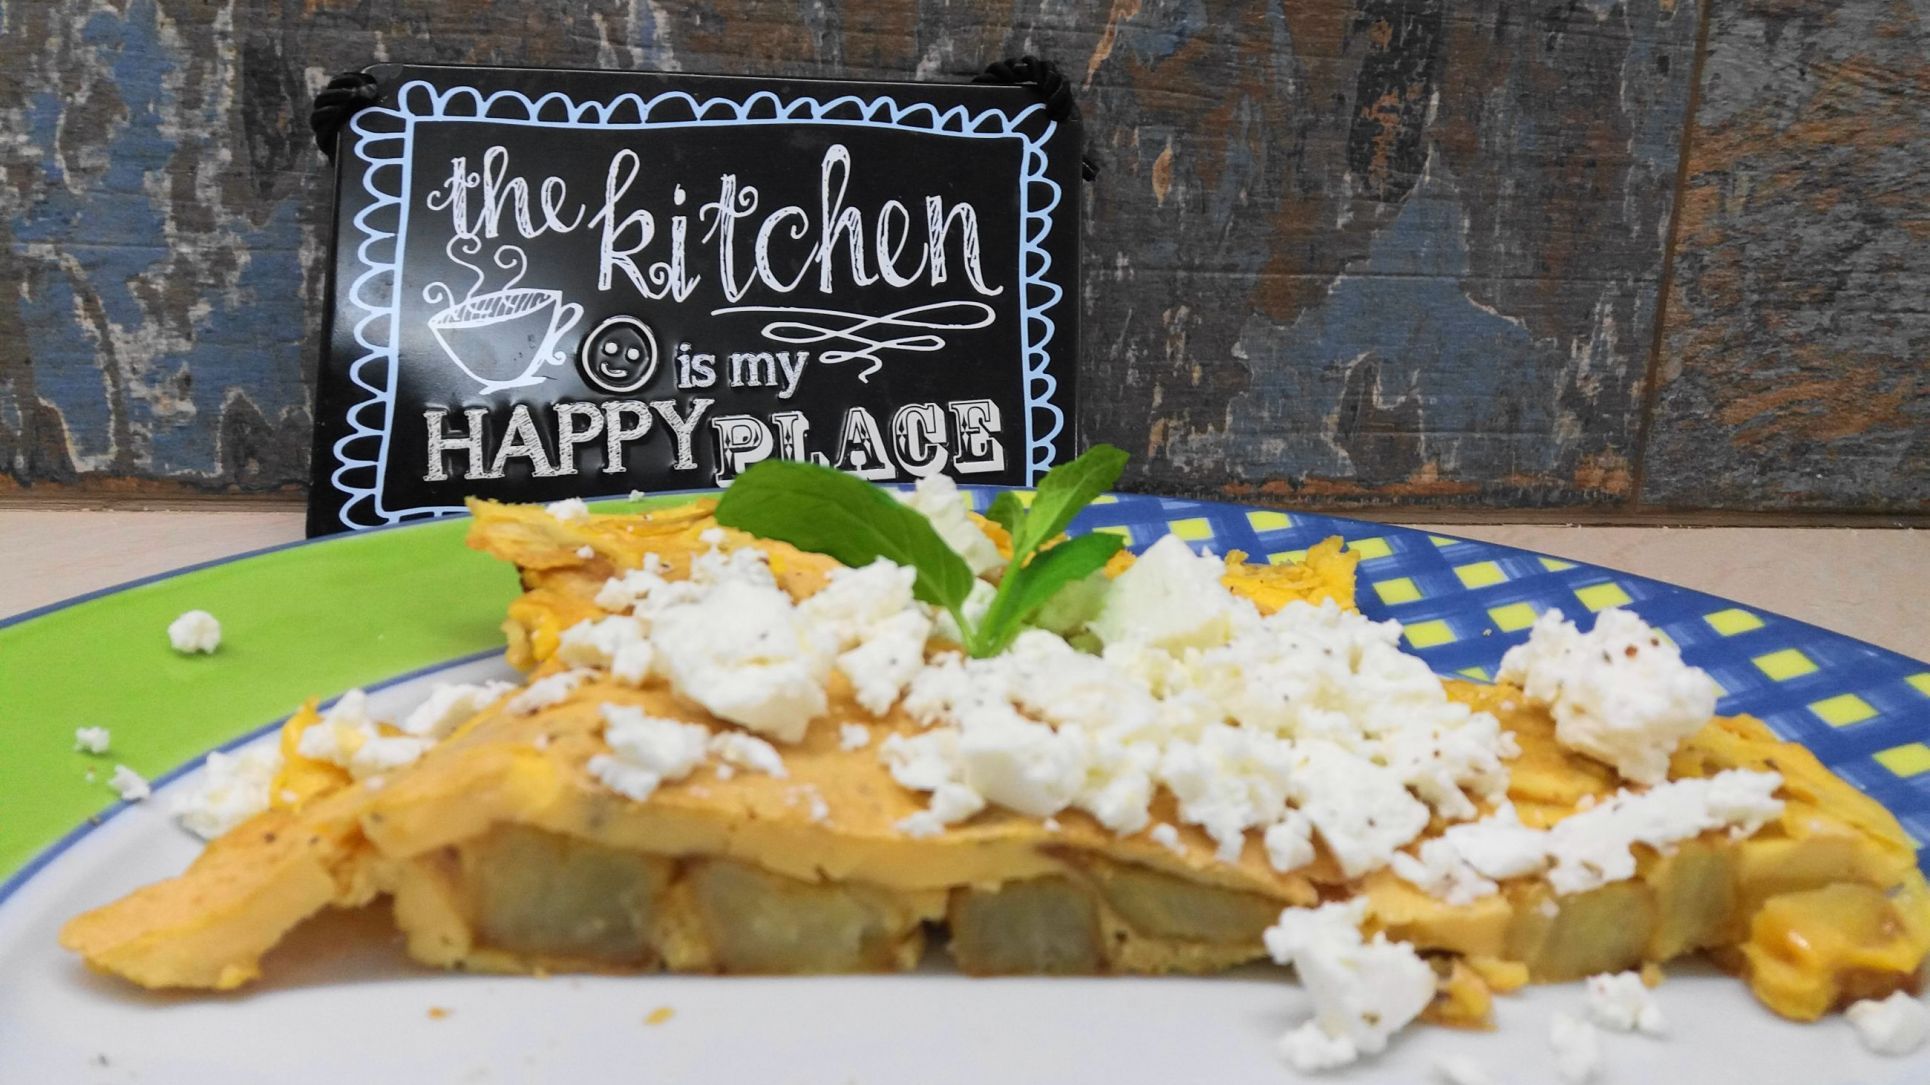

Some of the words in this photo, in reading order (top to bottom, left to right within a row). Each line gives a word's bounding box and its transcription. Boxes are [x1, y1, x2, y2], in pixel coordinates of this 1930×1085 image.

[428, 145, 585, 238] the
[588, 143, 1003, 302] kitchen
[676, 342, 716, 389] is
[729, 351, 810, 399] my
[422, 399, 715, 482] HAPPY
[711, 398, 1005, 488] PLACE
